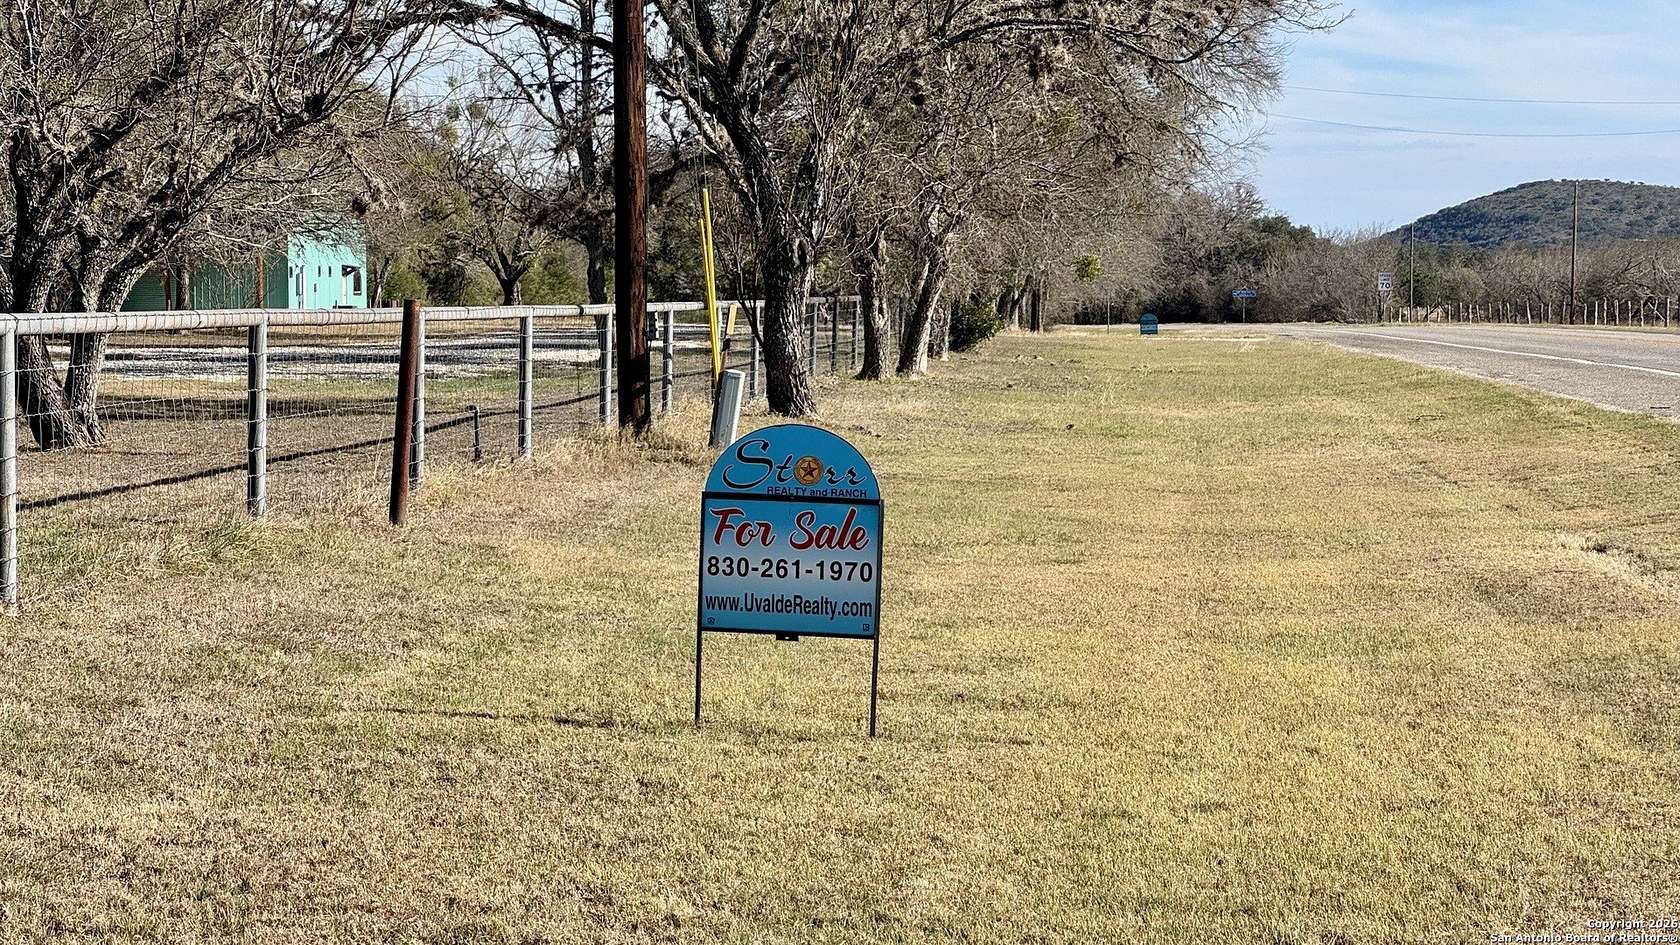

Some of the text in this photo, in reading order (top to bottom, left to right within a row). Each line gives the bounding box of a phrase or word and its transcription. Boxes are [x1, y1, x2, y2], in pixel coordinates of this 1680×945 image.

[766, 486, 807, 496] REALTY
[830, 488, 867, 498] RANCH
[709, 507, 870, 550] For Sale
[707, 555, 873, 582] 830-261-1970
[705, 592, 873, 620] www.UvaldeRealty.com
